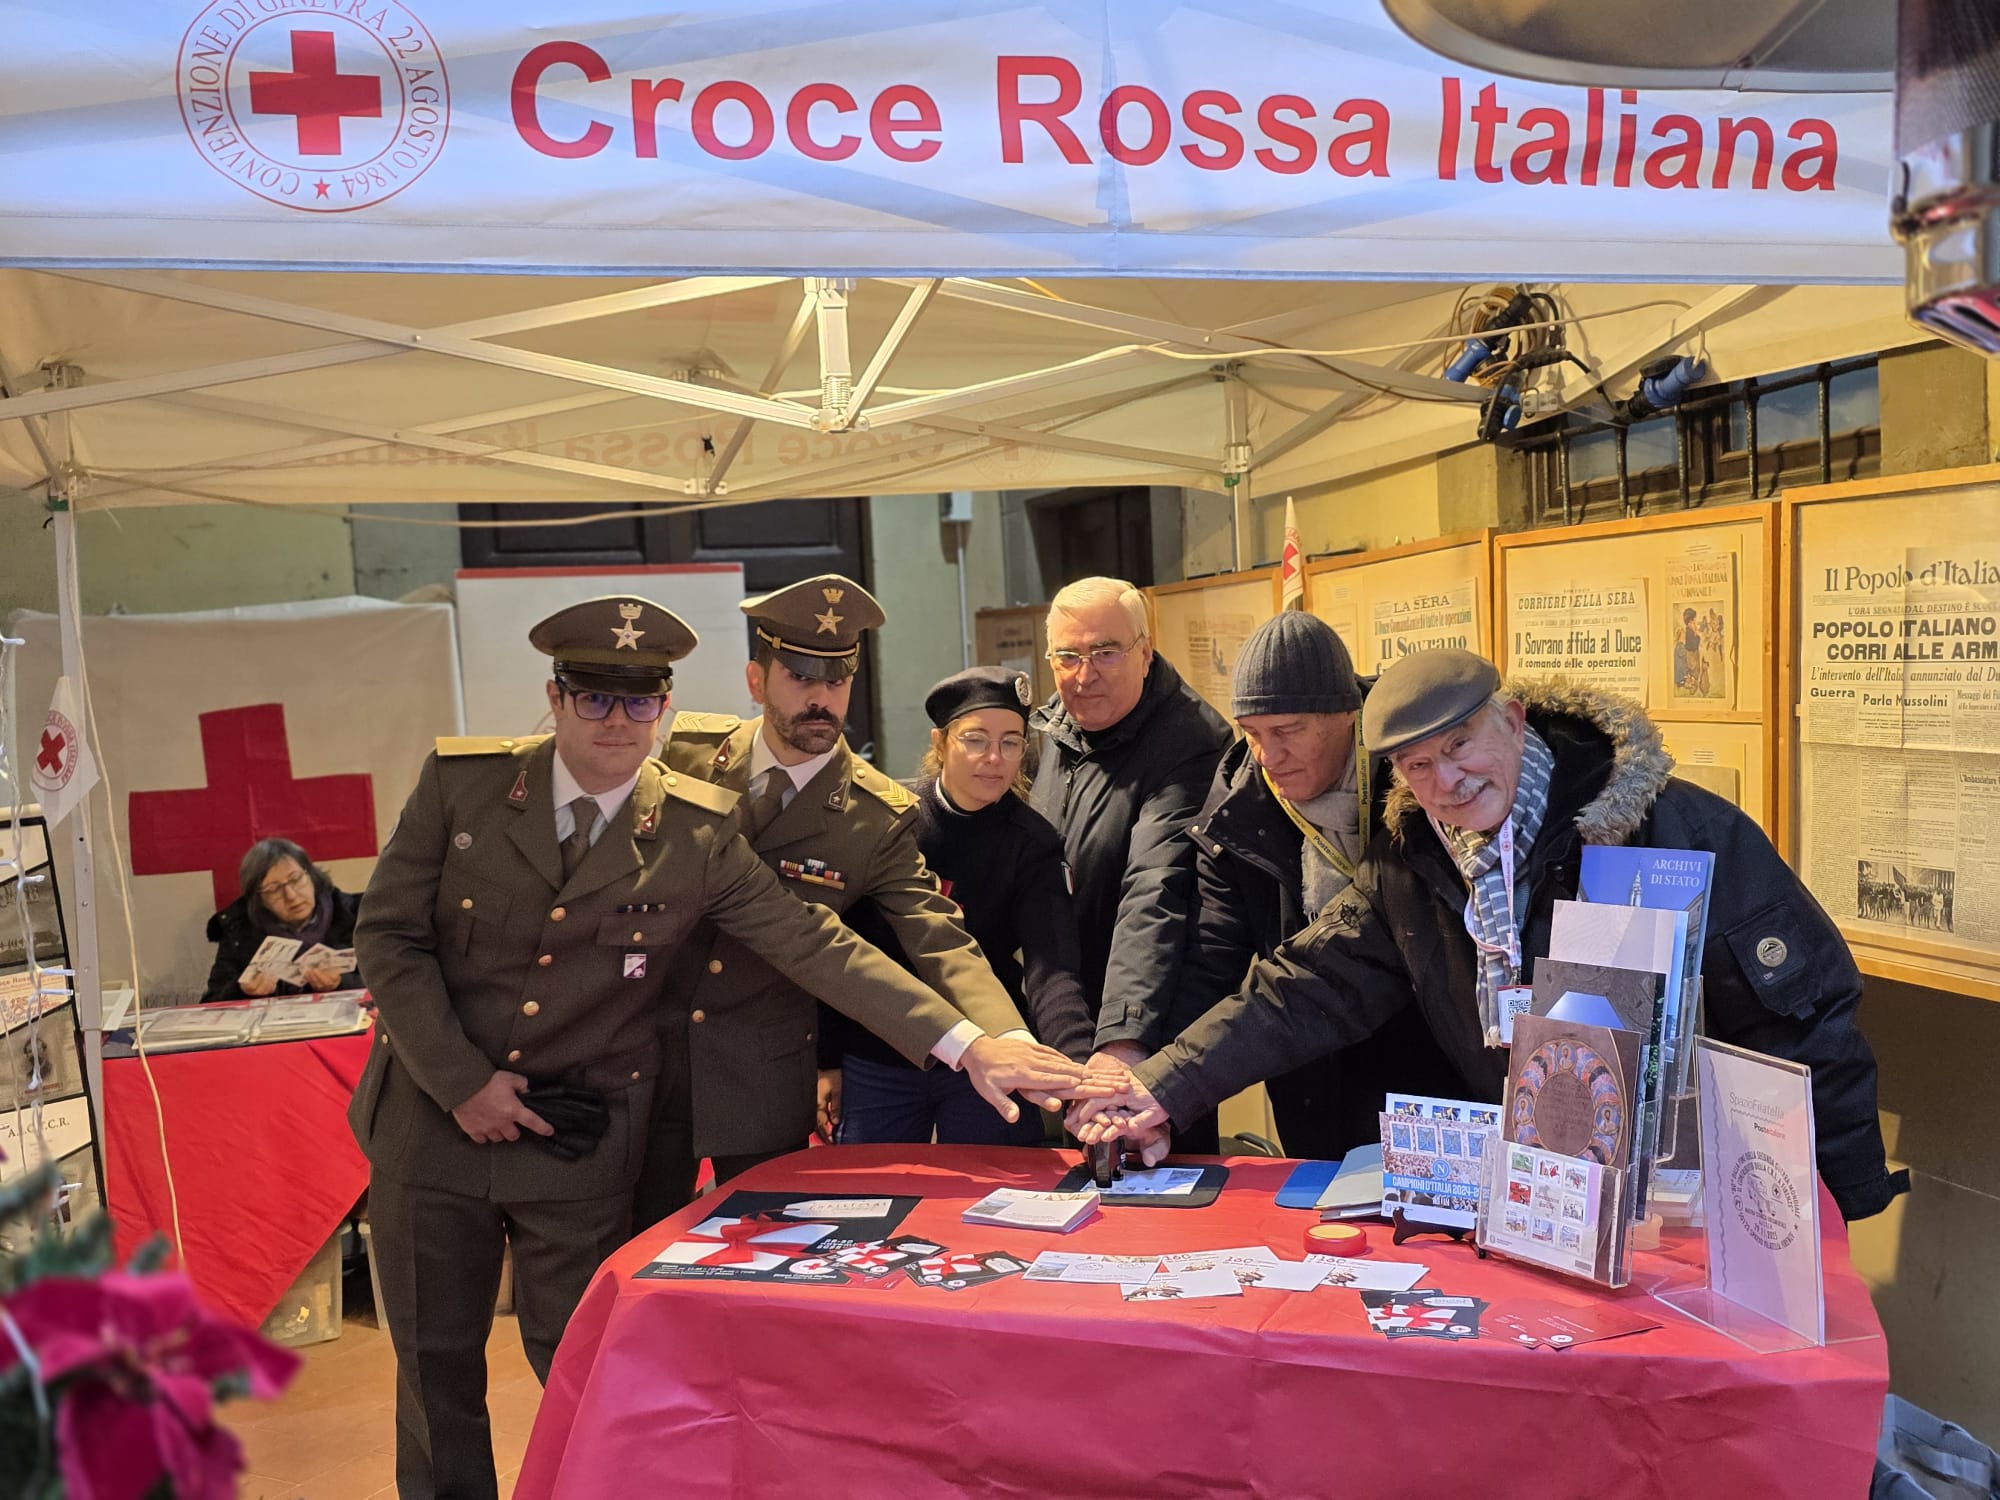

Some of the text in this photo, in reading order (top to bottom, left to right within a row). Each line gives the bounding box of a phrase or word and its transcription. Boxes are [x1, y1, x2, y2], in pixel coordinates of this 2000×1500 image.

[190, 0, 440, 199] CONVENZIONE DI GVRA 22 AGOSTO 1864
[510, 40, 1839, 192] Croce Rossa Italiana
[1824, 559, 2000, 595] Il Popolo d'Italia
[1393, 594, 1450, 613] LA SERA
[1518, 595, 1566, 610] CORRIERE
[1607, 591, 1636, 606] SERA
[1904, 604, 1925, 614] DAL
[1926, 602, 1963, 613] DESTINO
[1813, 616, 1997, 639] POPOLO ITALIANO
[1381, 637, 1392, 660] Il
[1515, 628, 1642, 655] Il Sovrano affida al Duce
[1827, 643, 1887, 661] CORRI
[1893, 641, 1945, 661] ALLE
[1525, 657, 1562, 669] comando
[1564, 657, 1584, 669] delle
[1587, 655, 1636, 671] operazioni
[1811, 666, 1862, 682] L'intervento
[1910, 666, 1962, 682] annunziato
[1966, 666, 1982, 682] dal
[1810, 687, 1856, 698] Guerra
[1863, 692, 1948, 707] Parla Mussolini
[1652, 858, 1702, 873] ARCHIVI
[1651, 874, 1700, 888] DI STATO
[1436, 1163, 1447, 1174] N
[1392, 1175, 1425, 1191] CAMPIONI
[1425, 1178, 1452, 1193] D'ITALIA
